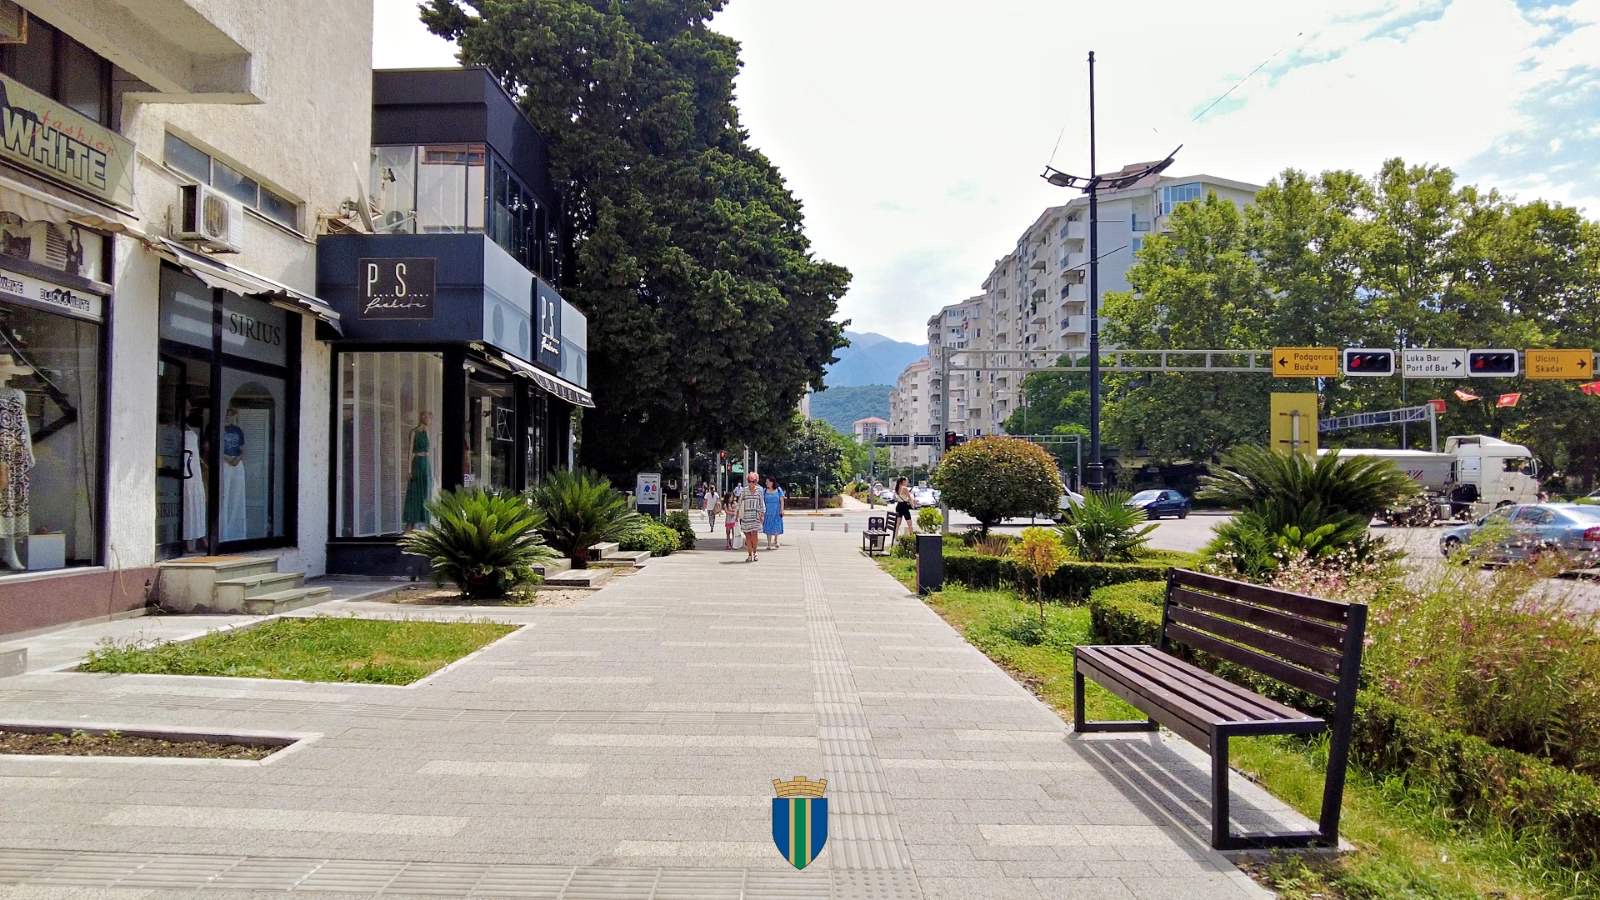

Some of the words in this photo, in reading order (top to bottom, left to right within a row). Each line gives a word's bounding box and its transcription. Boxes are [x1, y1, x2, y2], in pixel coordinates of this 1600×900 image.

[2, 106, 106, 191] WHITE
[229, 313, 281, 346] SIRIUS
[1294, 353, 1333, 362] Podgorica
[1406, 354, 1424, 362] Luka
[1426, 354, 1440, 362] Bar
[1535, 354, 1559, 364] Ulcinj
[1294, 363, 1319, 371] Budva
[1406, 364, 1423, 372] Port
[1425, 364, 1433, 372] of
[1435, 364, 1448, 372] Bar
[1535, 364, 1563, 373] Skadar
